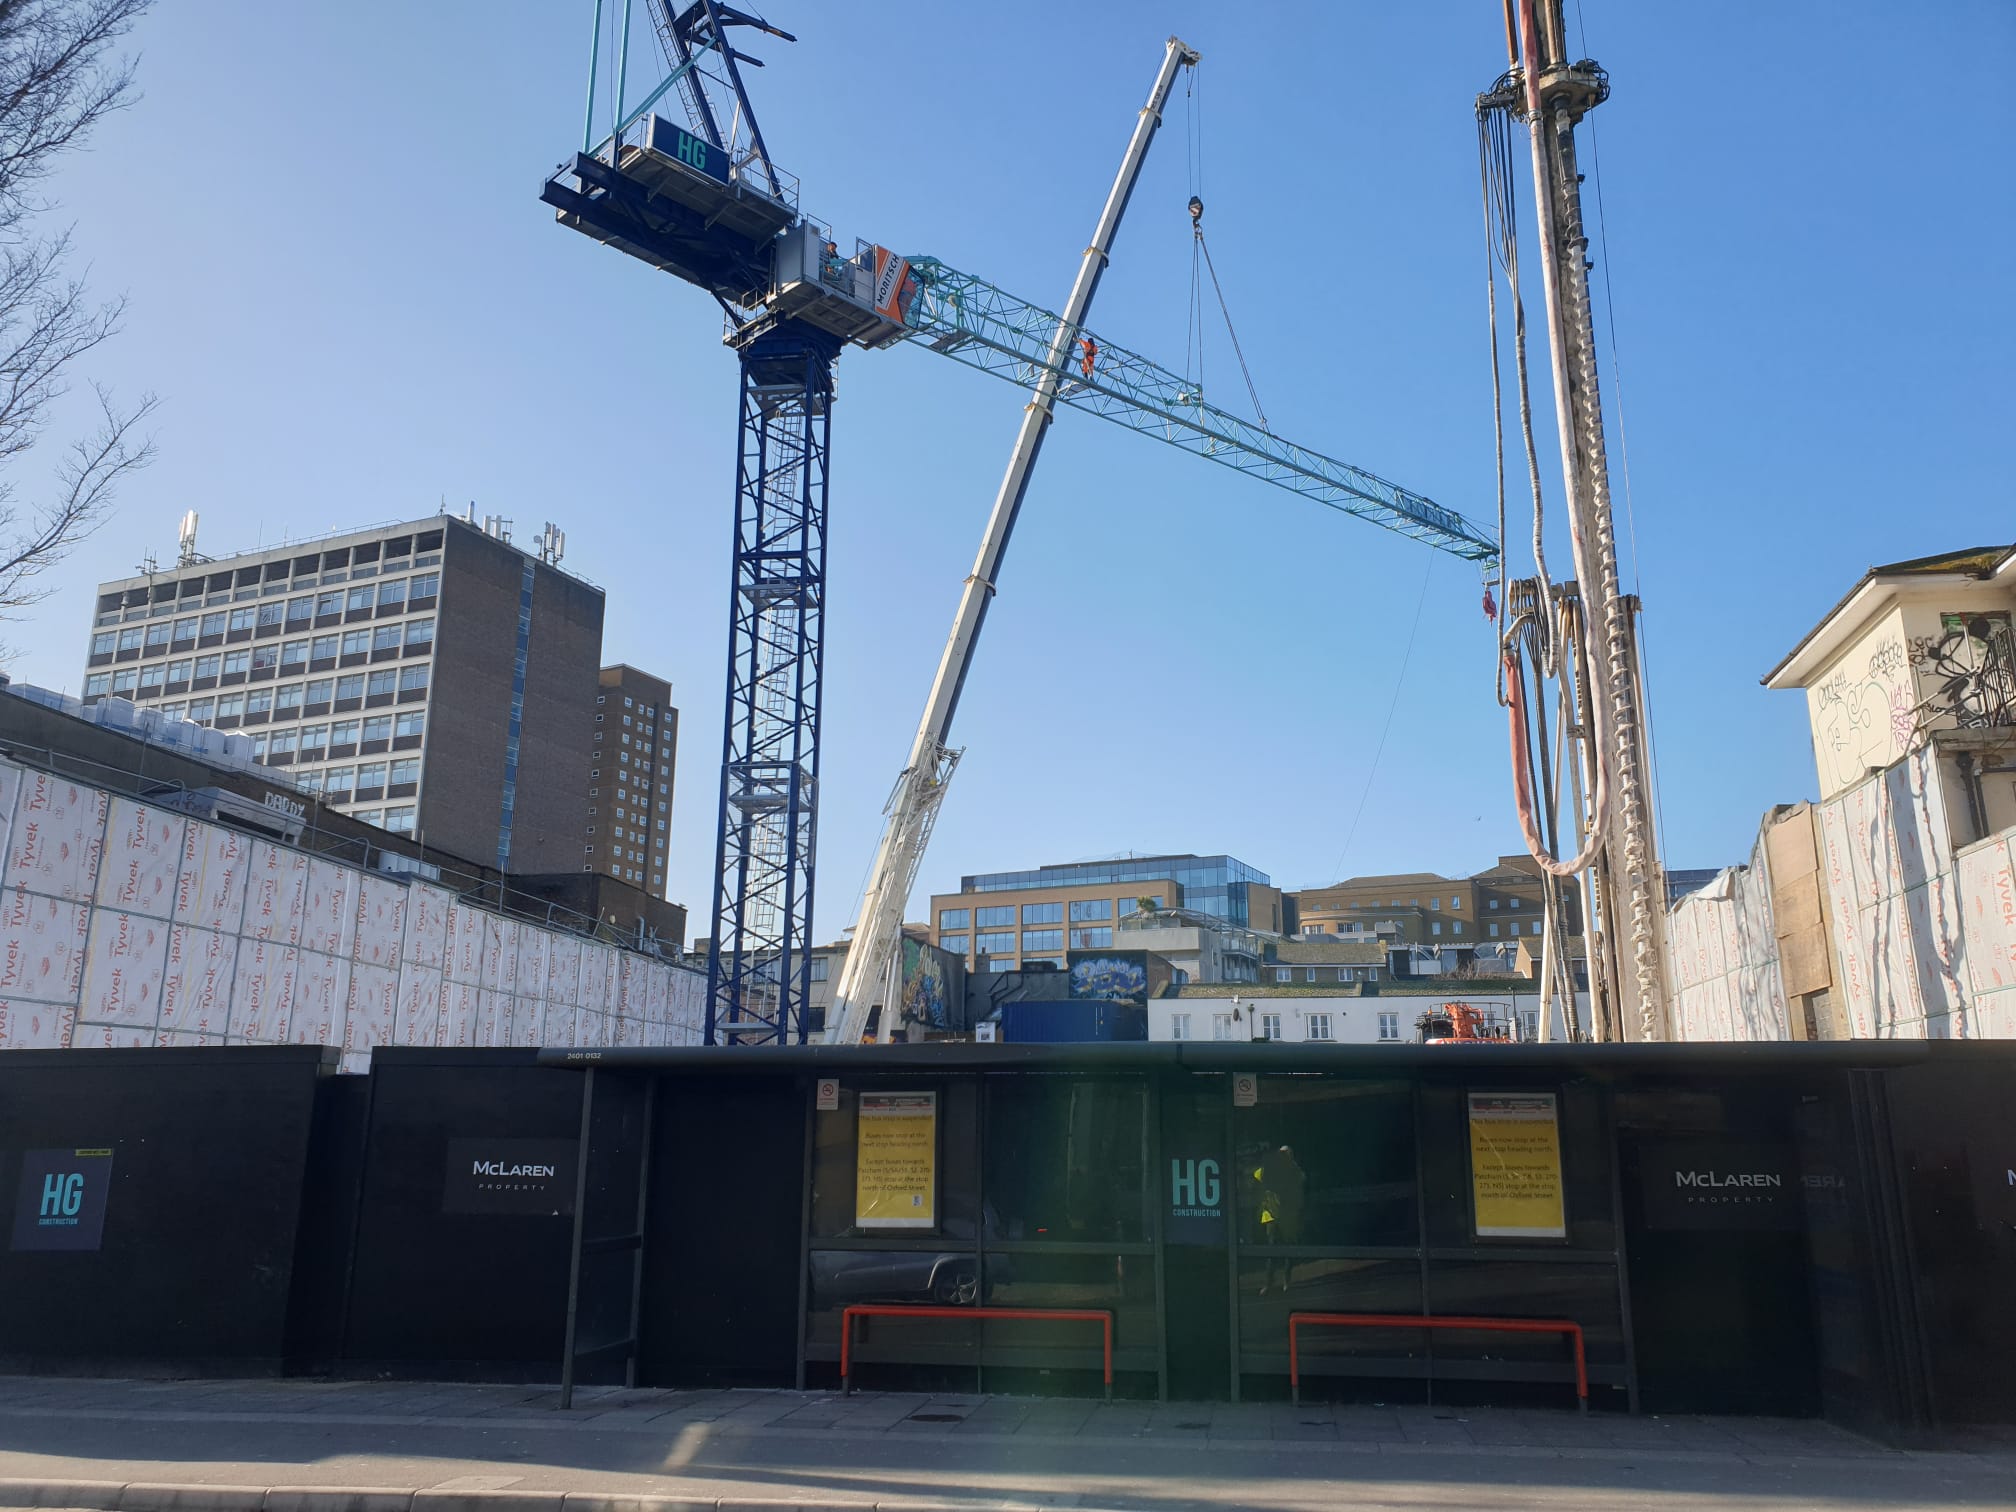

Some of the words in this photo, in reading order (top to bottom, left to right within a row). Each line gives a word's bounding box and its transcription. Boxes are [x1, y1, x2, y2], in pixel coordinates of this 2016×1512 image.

[678, 131, 706, 170] HG
[877, 254, 899, 304] MORITSCH
[29, 775, 46, 811] Tyve
[97, 790, 108, 827] yvek
[20, 822, 38, 868] Tyvek
[132, 807, 145, 849] Tyvek
[187, 822, 198, 861] Tyvek
[123, 860, 138, 903] Tyvek
[178, 871, 192, 911] Tyvek
[262, 880, 273, 916] Tyvek
[1996, 869, 2016, 926] Tyvek
[115, 914, 128, 957] Tyvek
[1, 940, 19, 987] Tyvek
[70, 948, 84, 993] Tyvek
[107, 968, 121, 1012] Tyvek
[164, 974, 178, 1016] Tyvek
[250, 974, 262, 1012] Tyvek
[40, 1173, 84, 1216] HG
[1172, 1159, 1220, 1206] HG
[1173, 1208, 1221, 1217] CONSTRUCTION
